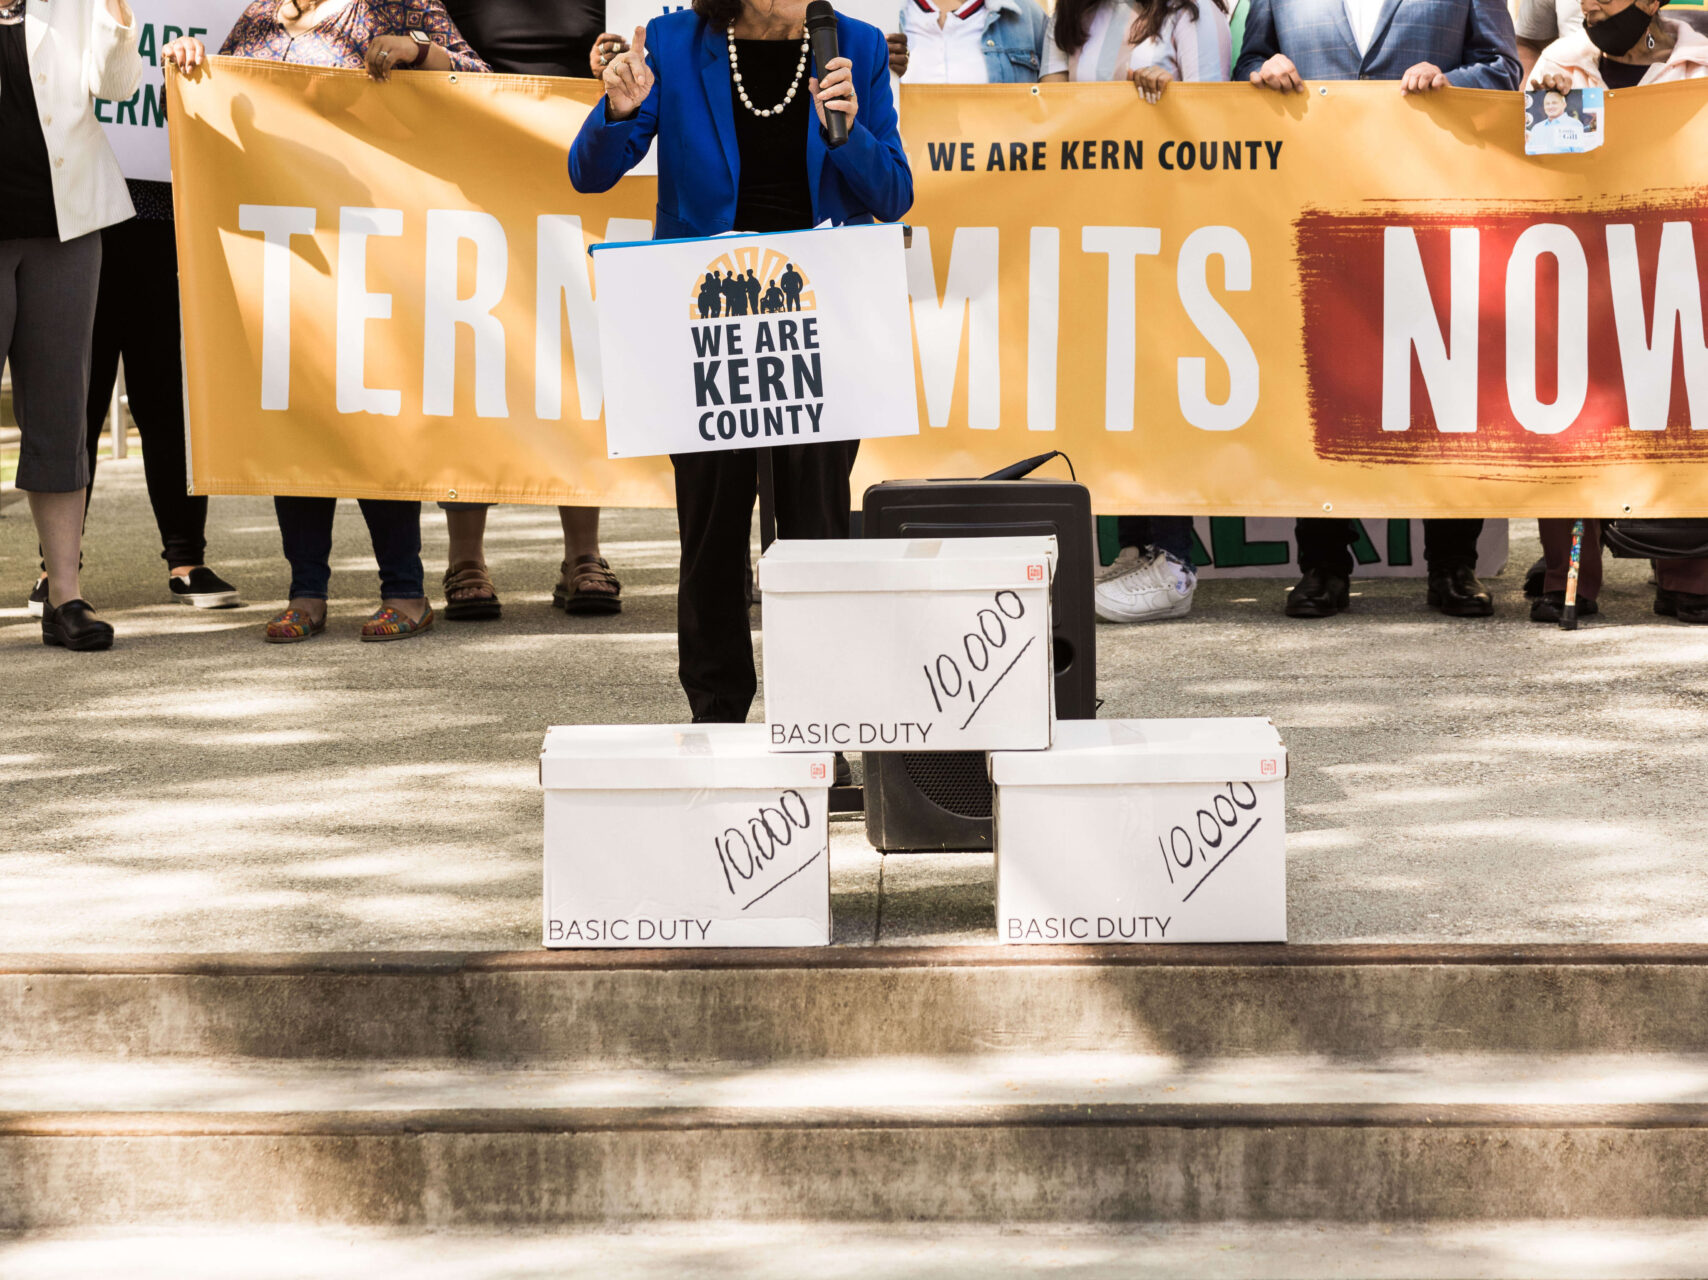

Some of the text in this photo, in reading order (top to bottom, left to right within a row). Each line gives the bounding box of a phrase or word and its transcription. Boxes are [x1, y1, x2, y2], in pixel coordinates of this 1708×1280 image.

[94, 83, 165, 128] ERN
[928, 140, 1283, 171] WE ARE KERN COUNTY
[691, 317, 820, 358] WE ARE
[903, 225, 1260, 432] MITS
[1382, 221, 1708, 434] NOW
[693, 353, 823, 407] KERN
[698, 403, 824, 441] COUNTY
[924, 590, 1025, 713] 10,000
[771, 722, 933, 744] BASIC DUTY
[715, 789, 810, 894] 10,000
[1159, 781, 1257, 884] 10,000
[549, 920, 712, 941] BASIC DUTY
[1008, 916, 1171, 939] BASIC DUTY
